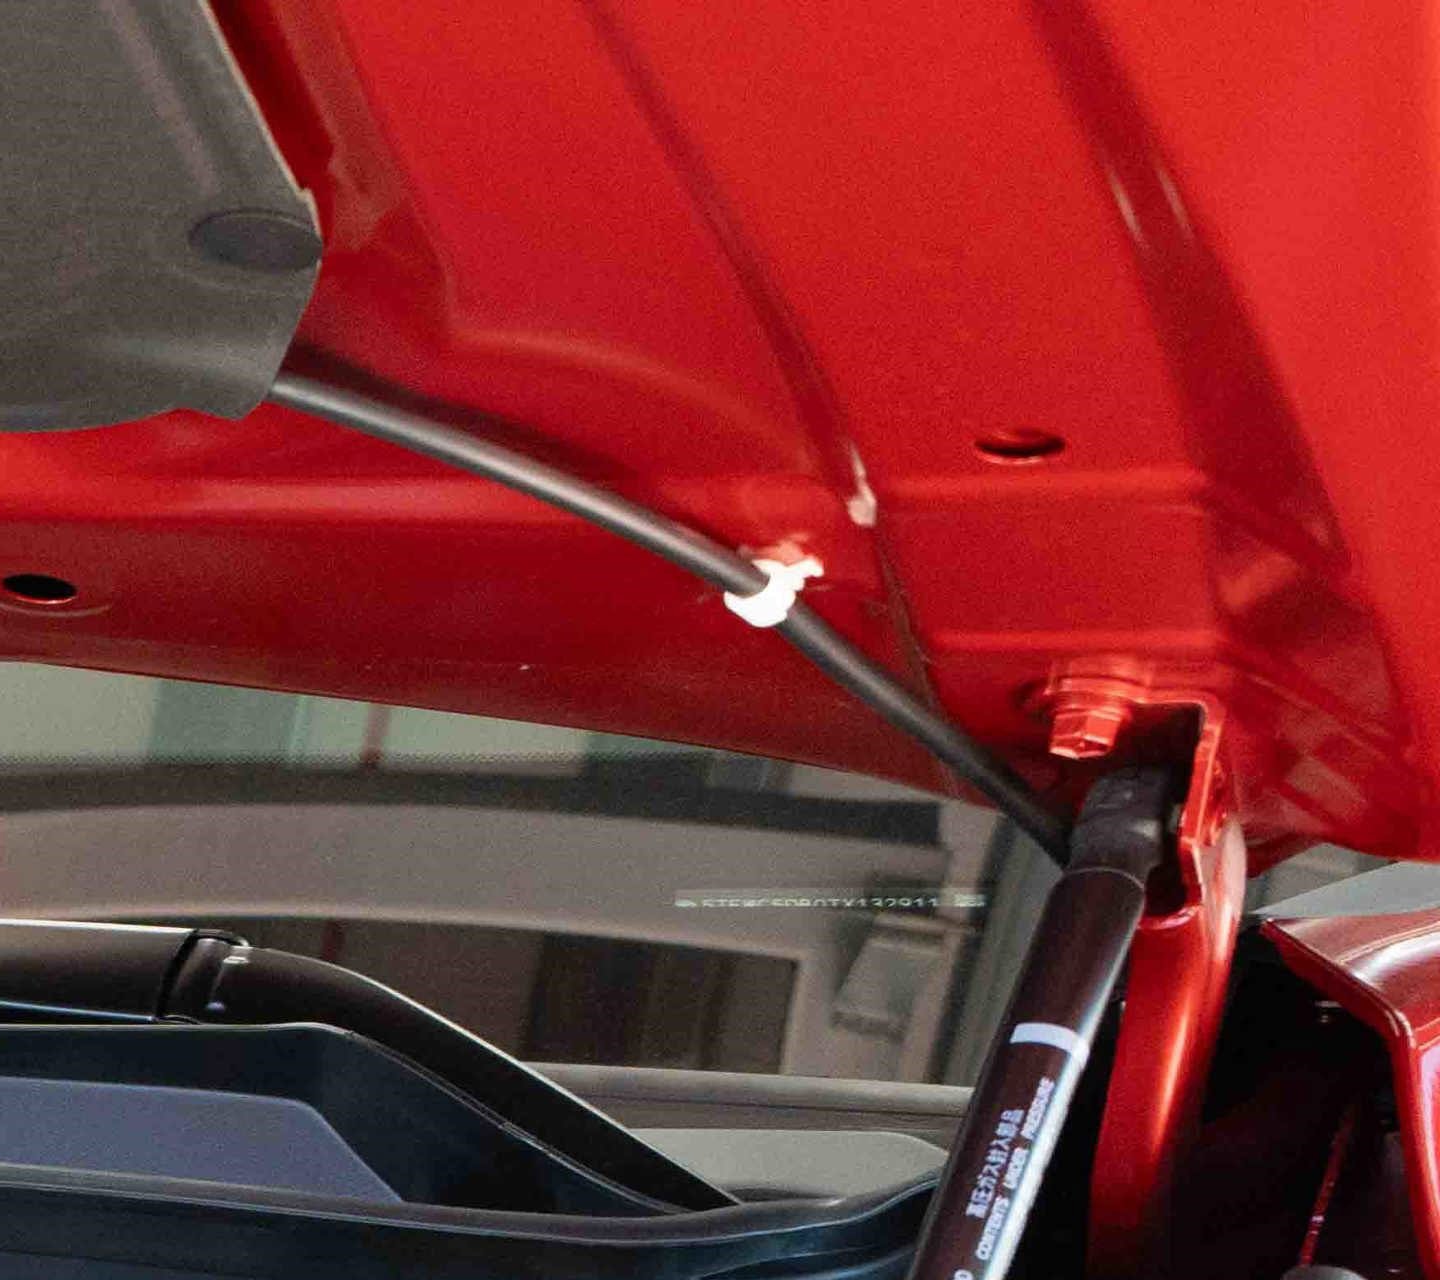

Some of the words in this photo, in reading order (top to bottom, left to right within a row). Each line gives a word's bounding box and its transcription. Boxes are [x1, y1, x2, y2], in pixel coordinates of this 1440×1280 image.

[974, 1196, 1010, 1261] CONTENTS
[1003, 1147, 1028, 1190] UNDER
[1020, 1077, 1055, 1141] PRESSURE
